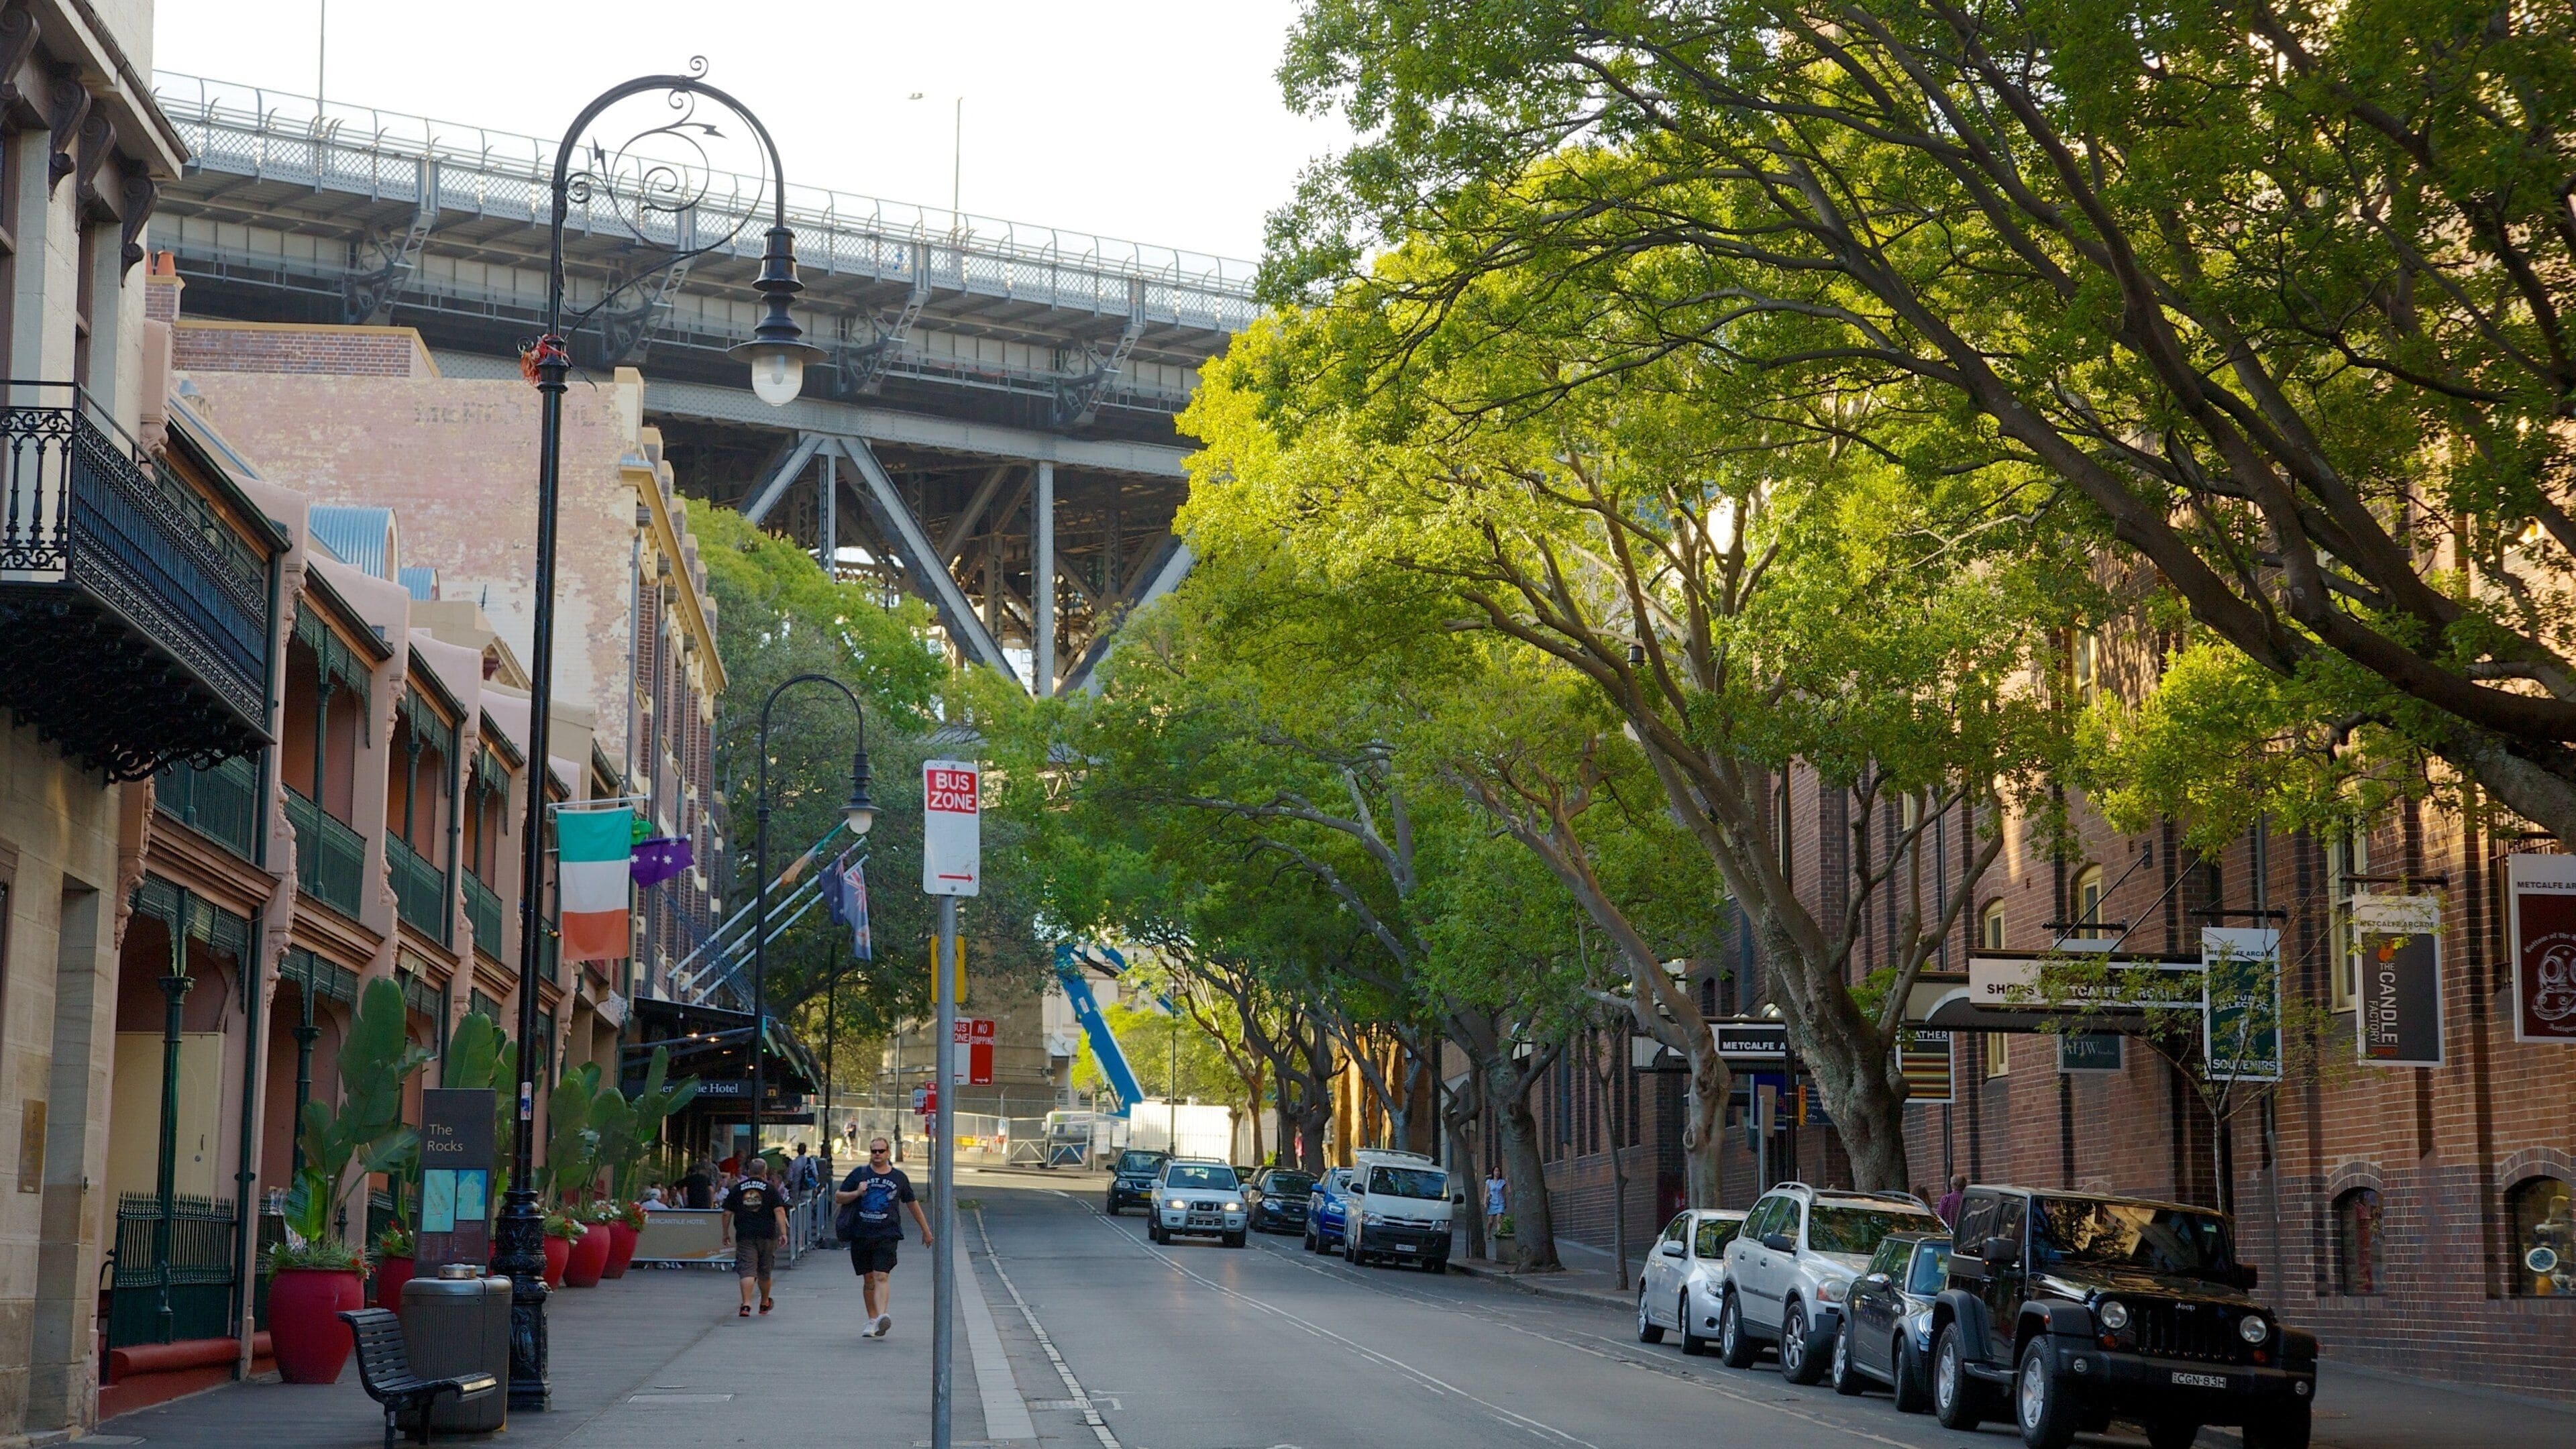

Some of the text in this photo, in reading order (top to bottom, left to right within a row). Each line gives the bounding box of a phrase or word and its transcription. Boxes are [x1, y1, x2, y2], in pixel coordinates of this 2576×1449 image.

[936, 772, 969, 791] BUS
[930, 791, 975, 810] ZONE
[2379, 963, 2396, 971] THE
[2379, 971, 2398, 1043] CANDLE
[2368, 1000, 2379, 1043] FACTORY
[955, 1023, 967, 1032] US
[977, 1024, 988, 1034] NO
[971, 1036, 994, 1045] STOPPING
[1722, 1041, 1775, 1051] METCALFE
[2063, 1040, 2100, 1055] AHW
[709, 1083, 739, 1093] Hotel
[429, 1123, 453, 1136] The
[427, 1140, 464, 1152] Rocks
[2175, 1302, 2196, 1311] Jeep
